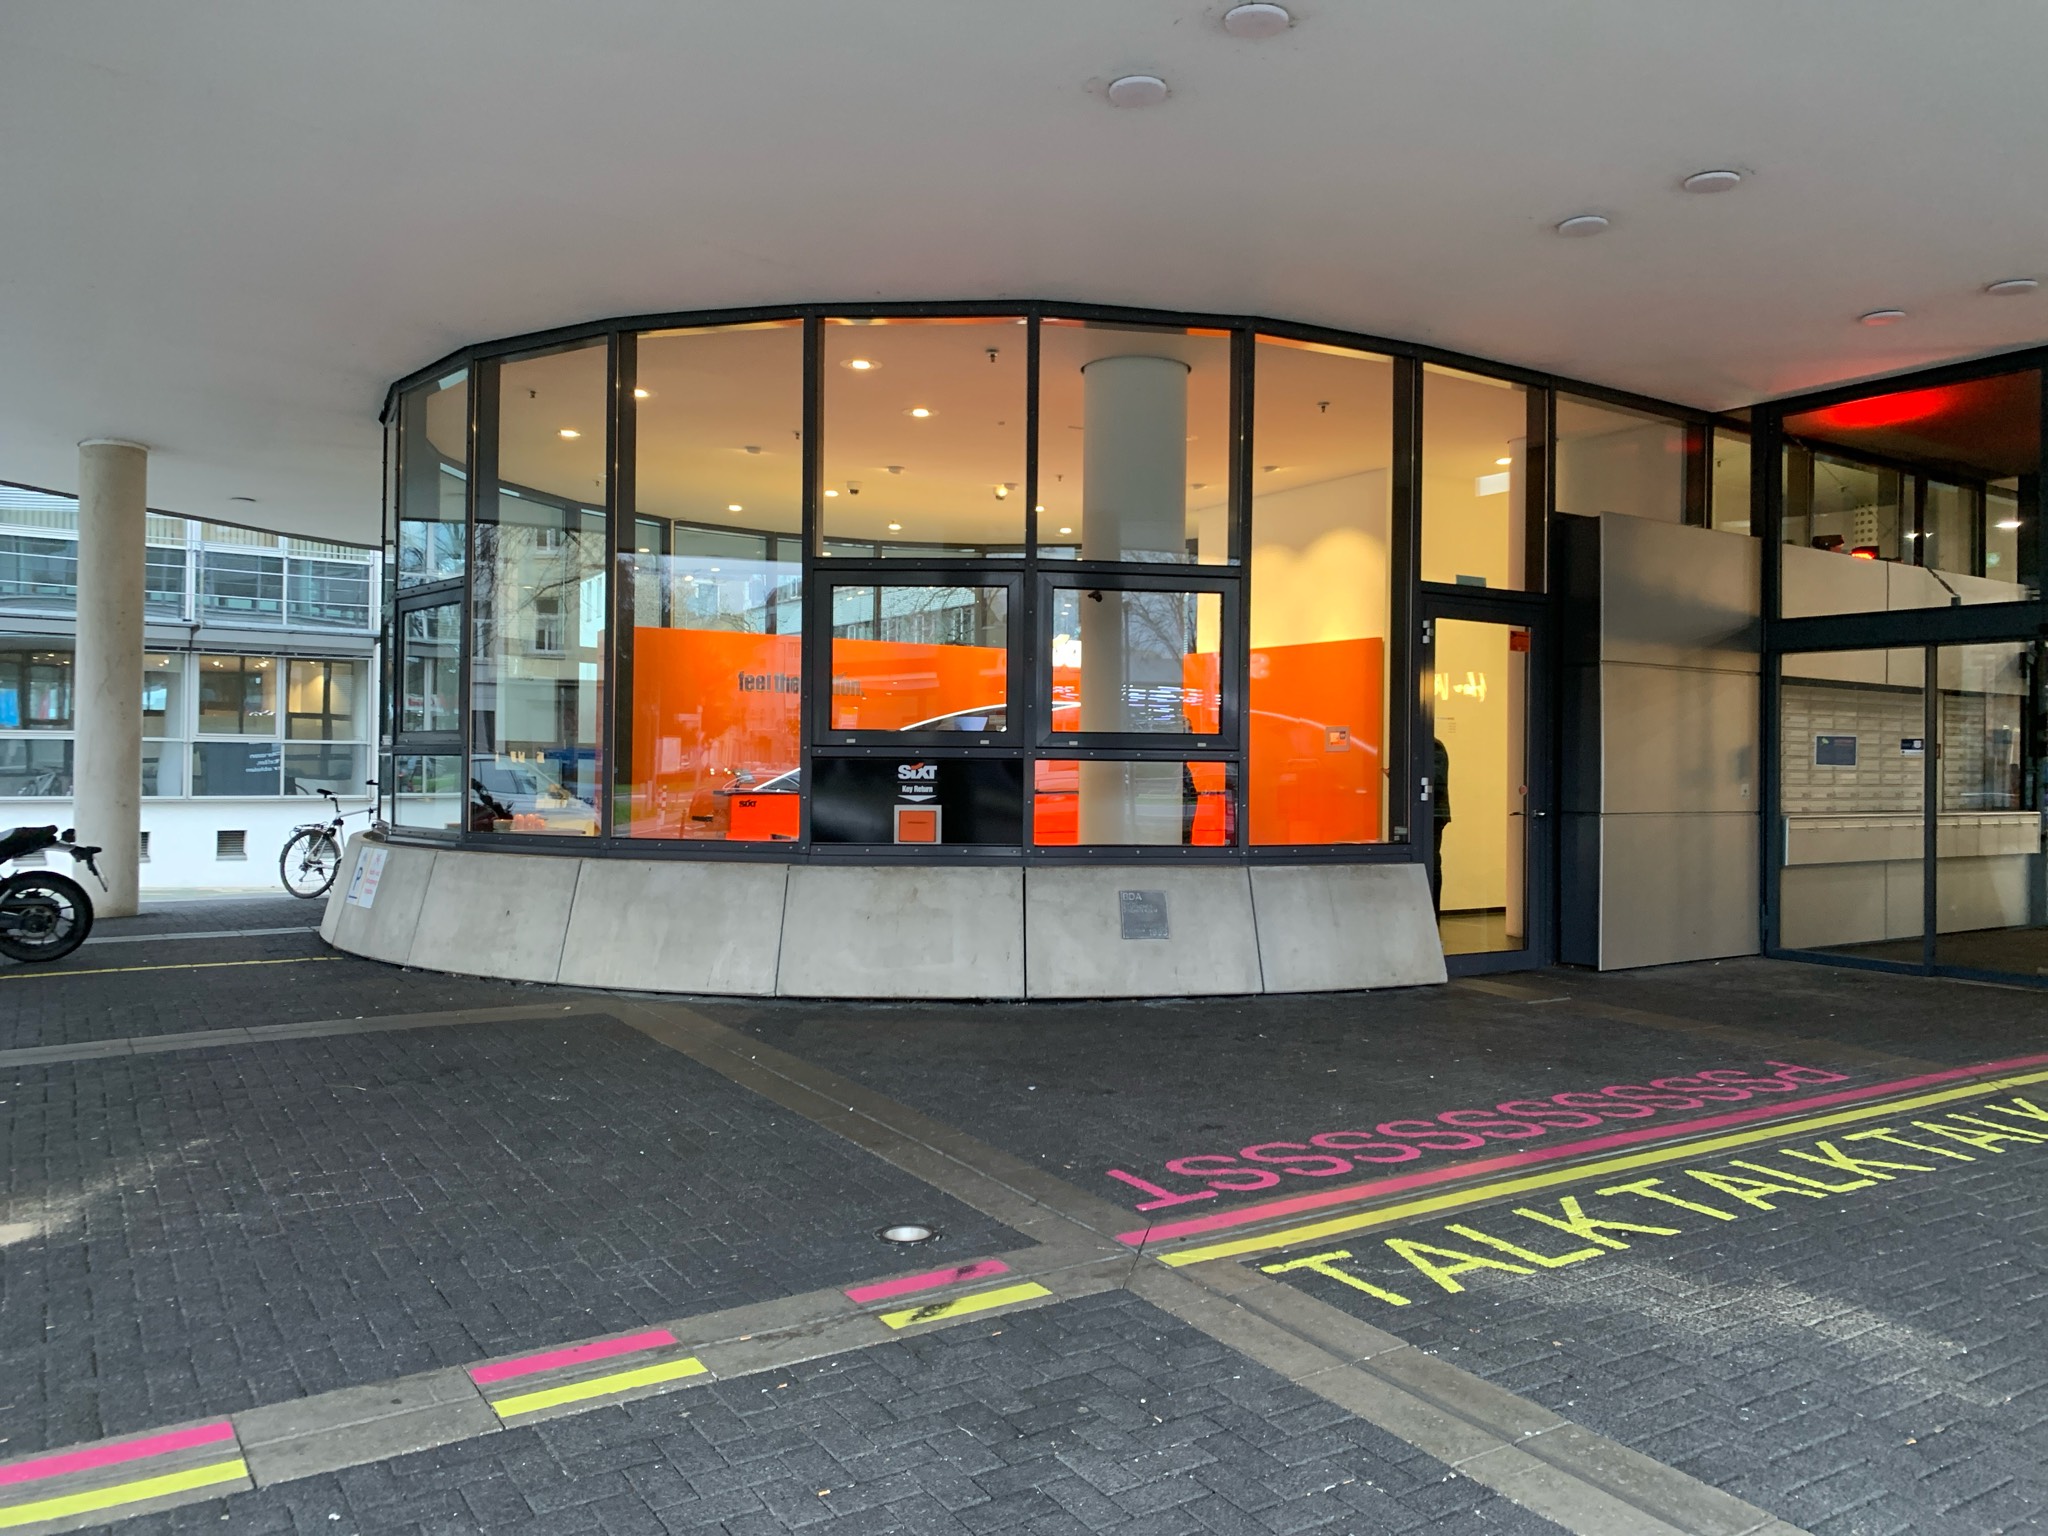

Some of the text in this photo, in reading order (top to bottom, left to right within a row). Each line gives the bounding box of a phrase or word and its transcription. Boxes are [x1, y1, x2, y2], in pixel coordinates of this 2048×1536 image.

[738, 671, 771, 692] feel
[774, 673, 799, 694] the
[901, 785, 933, 793] Key Return
[353, 866, 363, 890] P
